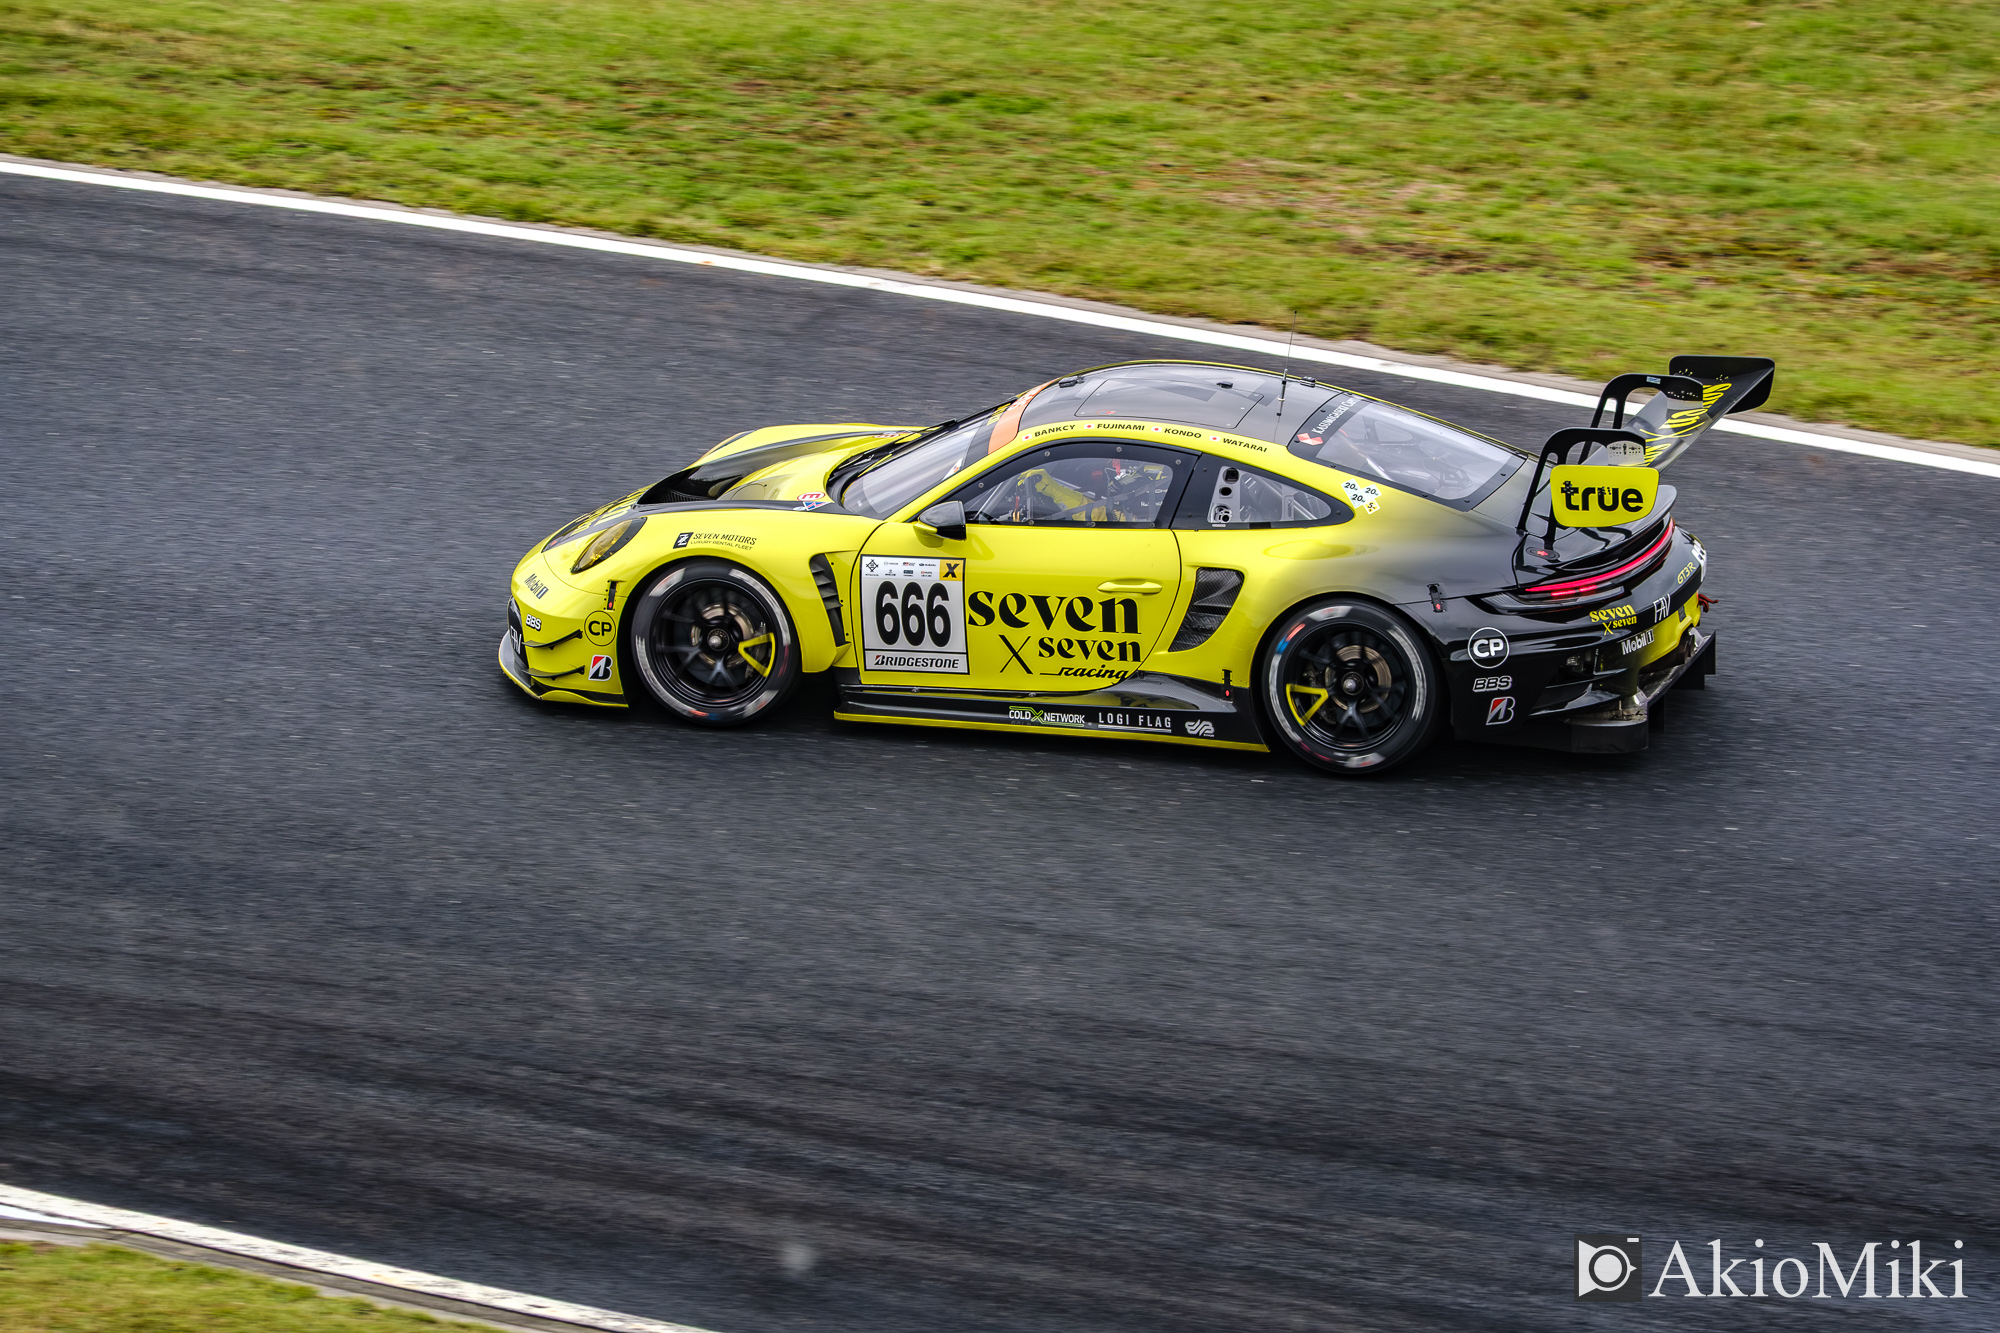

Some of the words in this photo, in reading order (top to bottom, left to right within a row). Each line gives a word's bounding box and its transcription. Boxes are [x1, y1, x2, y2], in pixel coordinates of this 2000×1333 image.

[1034, 424, 1076, 437] BANKCY
[1096, 423, 1145, 431] FUJINAMI
[1164, 427, 1202, 439] KONDO
[1223, 437, 1268, 453] WATARAI
[1560, 481, 1644, 513] true
[721, 534, 757, 545] MOTORS
[875, 580, 951, 647] 666
[968, 590, 1142, 635] seven
[1589, 604, 1637, 623] seven
[1653, 593, 1671, 623] FAV
[525, 613, 542, 631] BBS
[588, 620, 612, 637] CP
[1612, 615, 1637, 629] seven
[1473, 638, 1504, 658] CP
[1621, 632, 1647, 655] Mobil
[874, 655, 959, 669] BRIDGESTONE
[998, 634, 1033, 675] X
[1038, 637, 1142, 662] seven
[1060, 666, 1129, 685] racing
[1472, 675, 1512, 692] BBS
[1008, 710, 1031, 720] COLD
[1044, 712, 1085, 724] NETWORK
[1099, 712, 1130, 725] LOGI
[1139, 715, 1171, 728] FLAG
